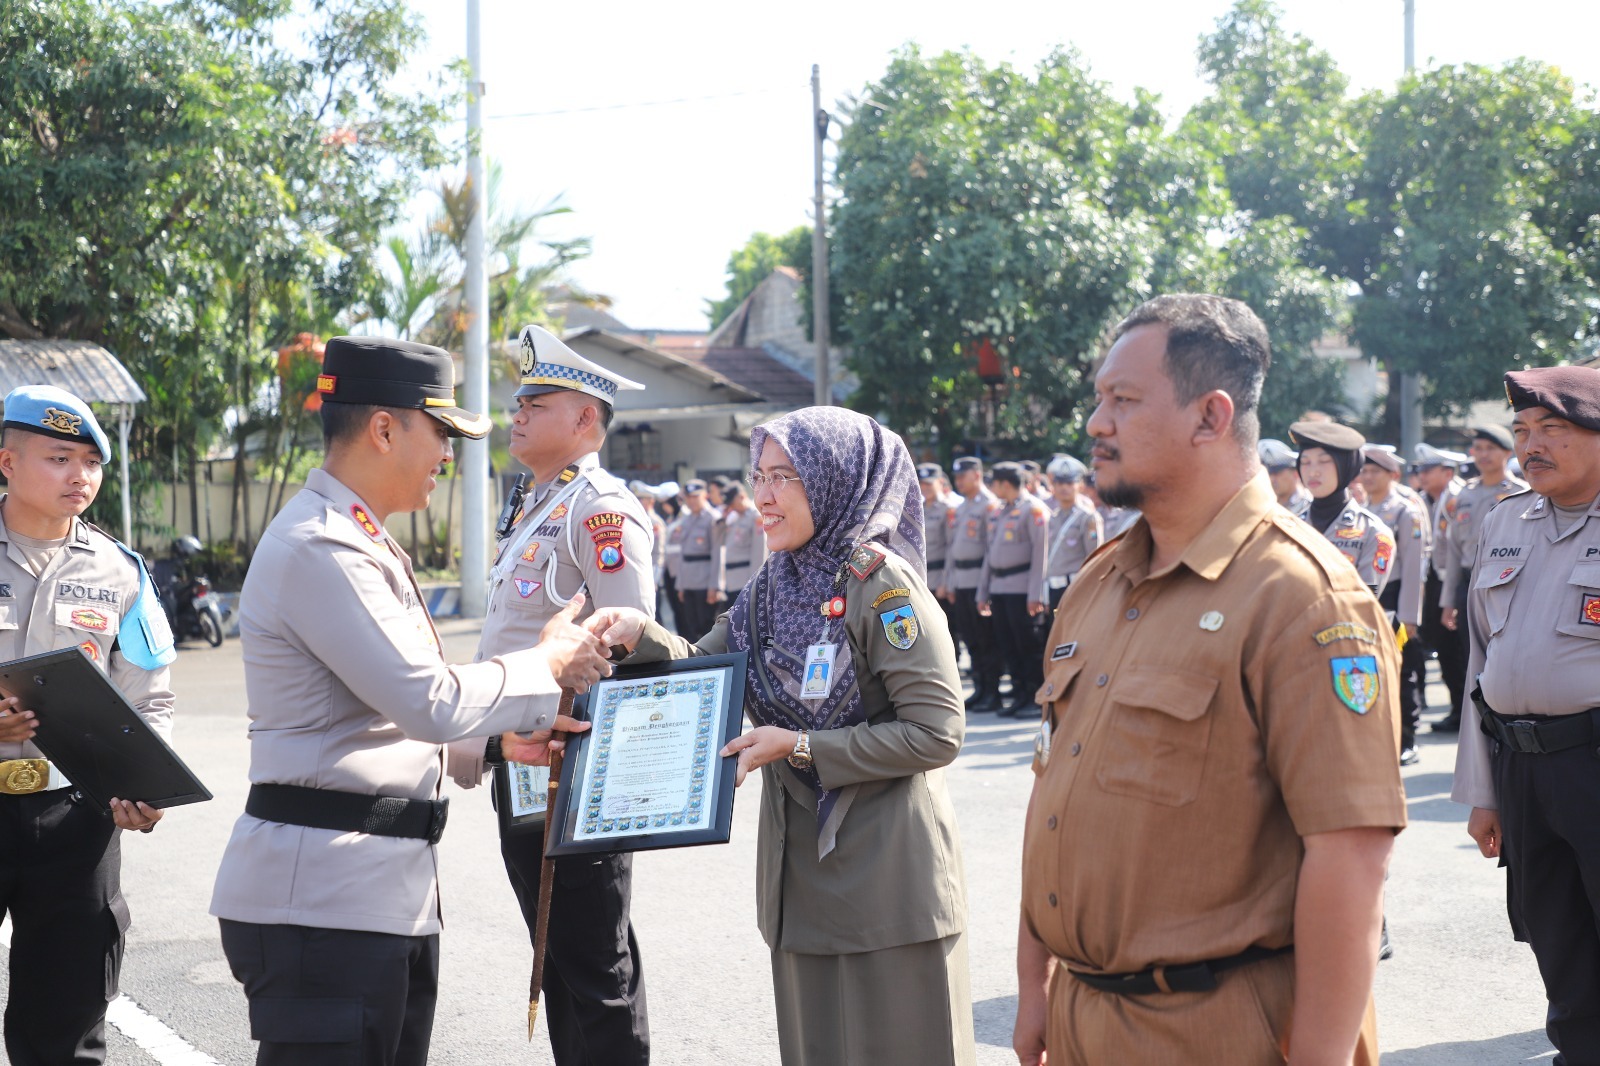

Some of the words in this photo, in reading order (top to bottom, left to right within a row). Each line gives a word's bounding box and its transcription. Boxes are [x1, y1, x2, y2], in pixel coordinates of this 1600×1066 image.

[1330, 540, 1364, 550] OLRI
[1490, 547, 1521, 557] RONI
[1585, 547, 1600, 558] P
[59, 584, 118, 603] POLRI
